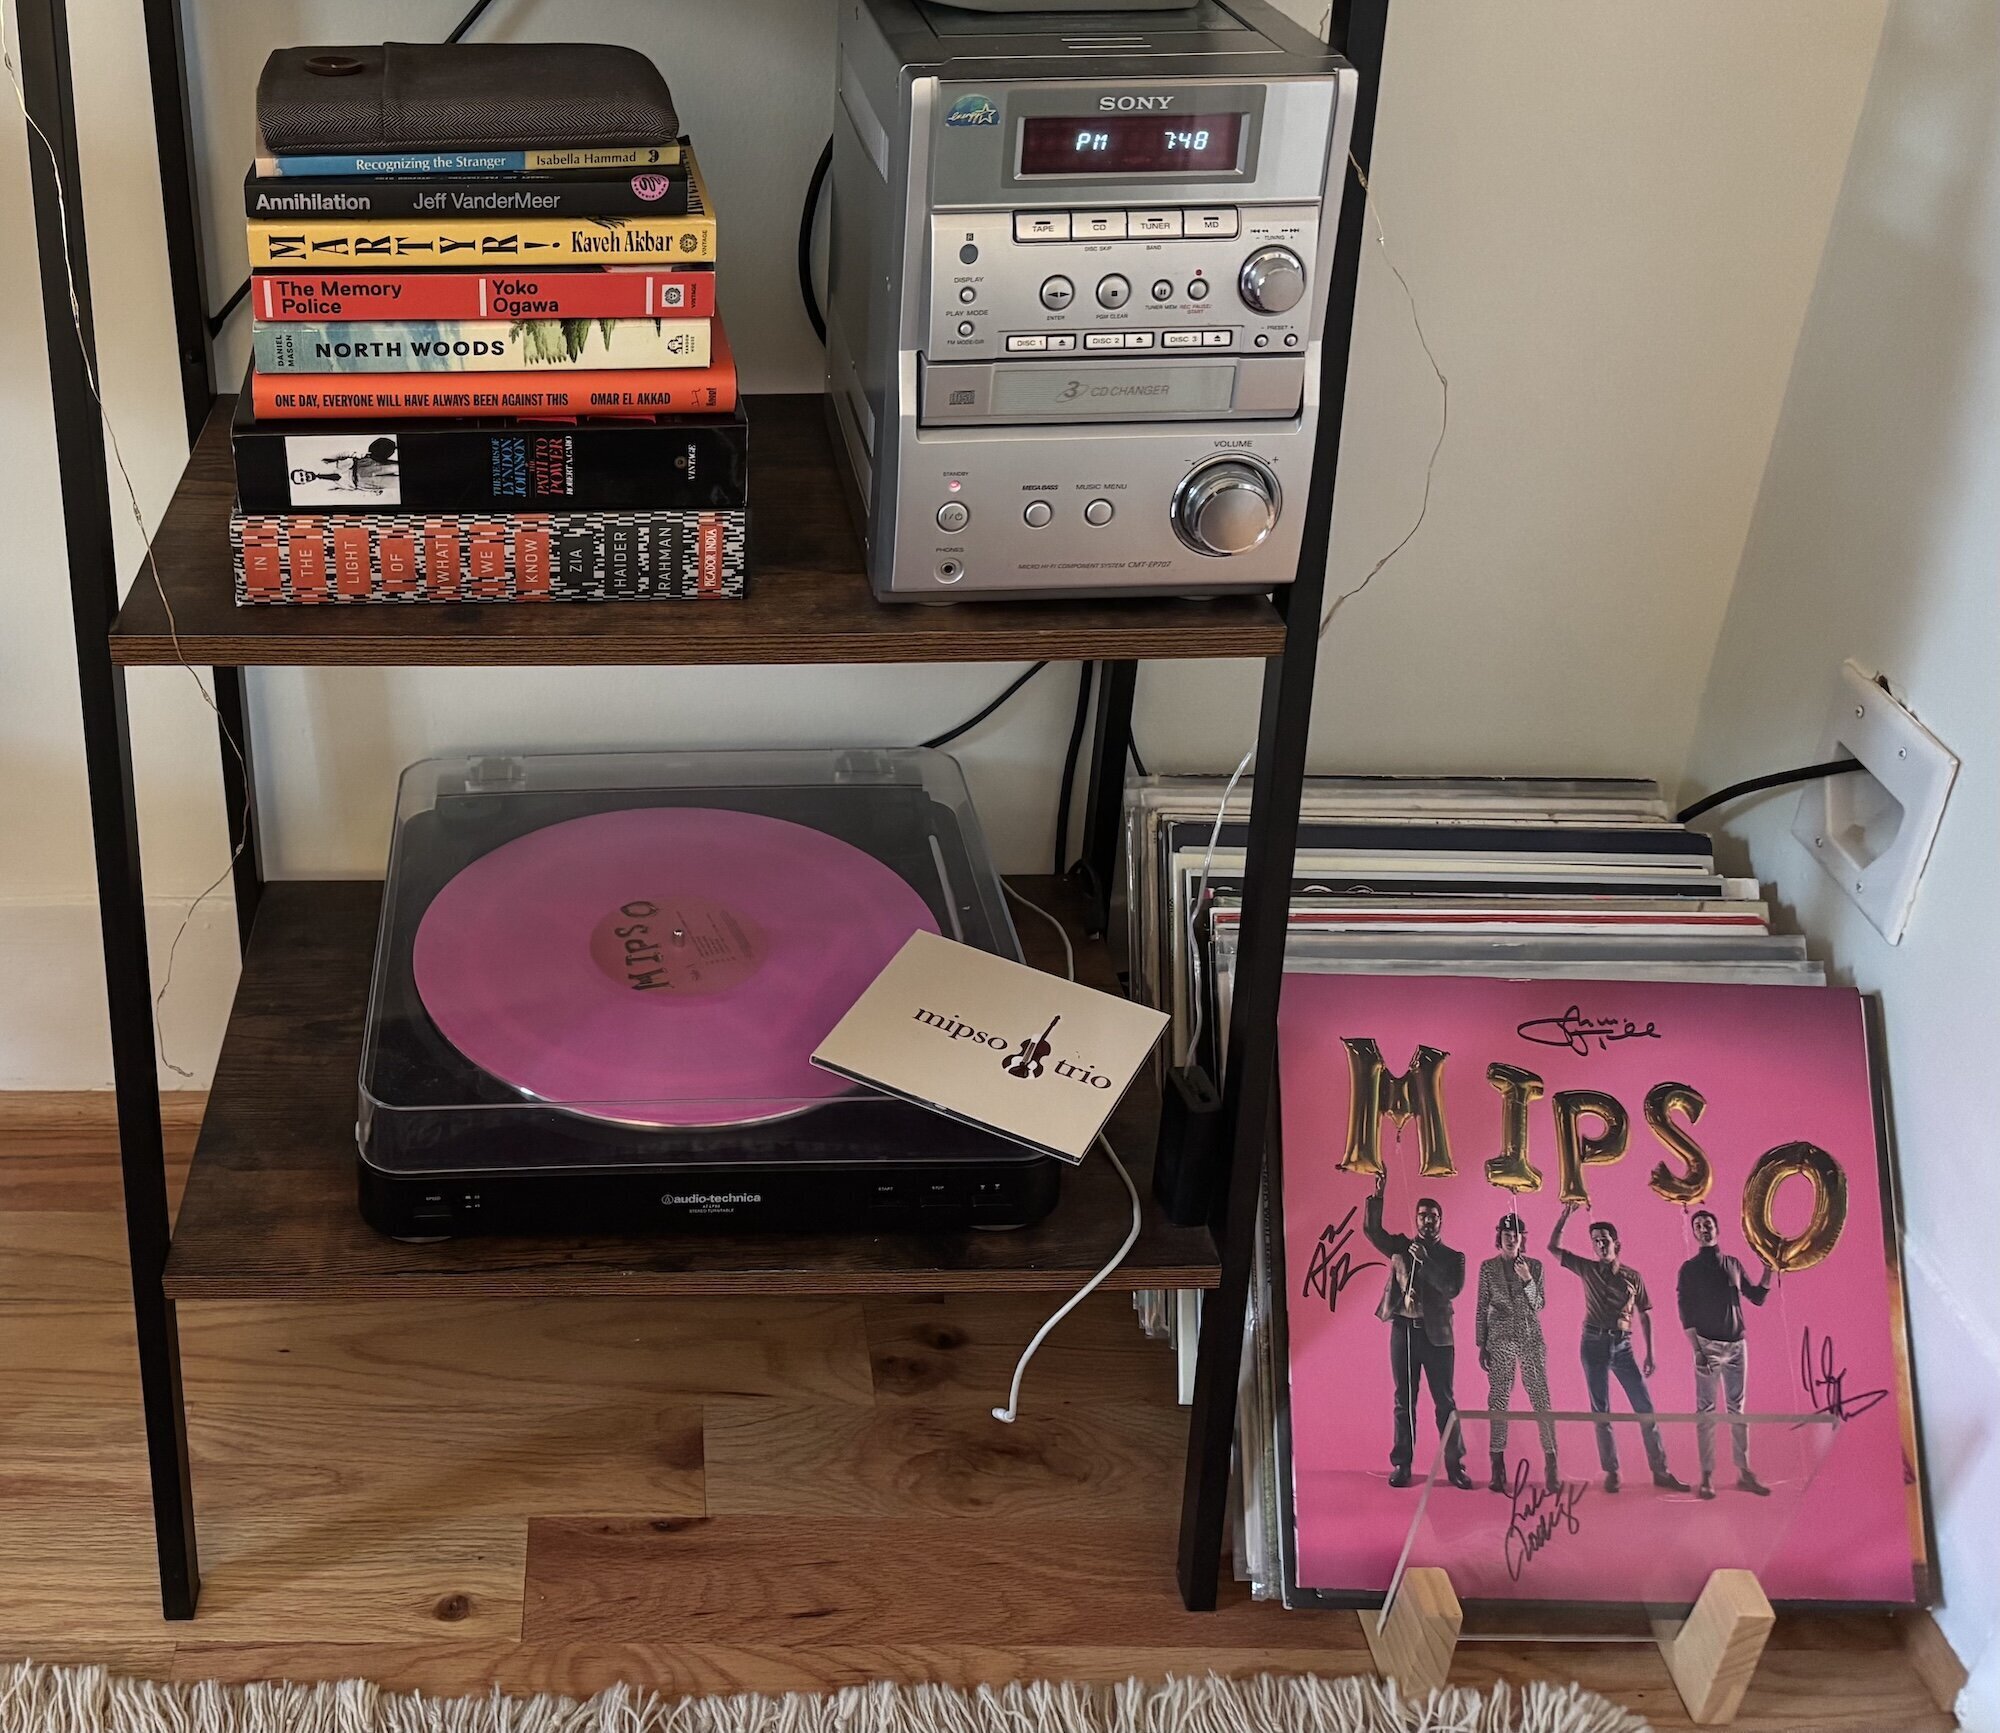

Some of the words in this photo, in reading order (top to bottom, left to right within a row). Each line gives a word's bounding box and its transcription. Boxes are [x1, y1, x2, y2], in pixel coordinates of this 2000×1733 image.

[1099, 96, 1175, 111] SONY
[1075, 132, 1109, 151] PM
[1165, 130, 1210, 150] 7:48
[356, 156, 433, 171] Recognizing
[434, 155, 452, 169] the
[457, 154, 506, 169] Stranger
[537, 153, 580, 166] Isabella
[584, 151, 636, 164] Hammad
[255, 193, 371, 211] Annihilation
[413, 193, 447, 210] Jeff
[450, 191, 561, 209] VanderMeer
[1032, 225, 1055, 233] TAPE
[1140, 222, 1171, 230] TUNER
[1204, 221, 1219, 229] MD
[268, 234, 561, 260] MARTYR!
[571, 230, 615, 253] Kaveh
[624, 229, 674, 252] Akbar
[701, 229, 709, 256] VINTAGE
[276, 281, 314, 296] The
[321, 281, 402, 298] Memory
[493, 280, 538, 295] Yoko
[282, 298, 342, 314] Police
[493, 297, 559, 316] Ogawa
[315, 342, 402, 358] NORTH
[410, 341, 505, 357] WOODS
[591, 393, 620, 405] OMAR
[622, 392, 634, 405] EL
[637, 392, 671, 405] AKKAD
[706, 387, 717, 407] Knopf
[1064, 380, 1079, 399] 3
[1090, 386, 1109, 398] CD
[1109, 384, 1170, 397] CHANGER
[275, 394, 296, 407] ONE
[298, 394, 320, 409] DAY,
[323, 394, 374, 407] EVERYONE
[377, 393, 401, 407] WILL
[404, 393, 429, 406] HAVE
[433, 393, 470, 406] ALWAYS
[473, 393, 499, 406] BEEN
[502, 393, 540, 406] AGAINST
[542, 393, 568, 406] THIS
[491, 437, 500, 450] OF
[535, 437, 549, 459] TO
[565, 435, 573, 457] CARO
[1213, 440, 1253, 448] VOLUME
[492, 450, 501, 477] YEARS
[501, 437, 514, 496] LYNDON
[513, 437, 527, 498] JOHNSON
[549, 437, 564, 495] POWER
[688, 444, 697, 480] VINTAGE
[492, 478, 501, 497] THE
[535, 461, 549, 495] PATH
[565, 464, 574, 496] ROBERT
[703, 528, 717, 553] INDIA
[254, 556, 268, 571] IN
[299, 549, 314, 577] THE
[345, 541, 360, 584] LIGHT
[390, 553, 404, 572] OF
[435, 541, 450, 584] WHAT
[480, 550, 493, 574] WE
[525, 538, 539, 584] KNOW
[569, 548, 583, 573] ZIA
[614, 531, 627, 588] HAIDER
[658, 526, 672, 591] RAHMAN
[703, 553, 716, 588] PICADOR
[614, 900, 675, 991] MIPSO
[912, 1007, 1008, 1051] mipso
[1054, 1058, 1112, 1090] trio
[1335, 1035, 1848, 1273] MIPSO
[673, 1192, 761, 1204] audio-technica
